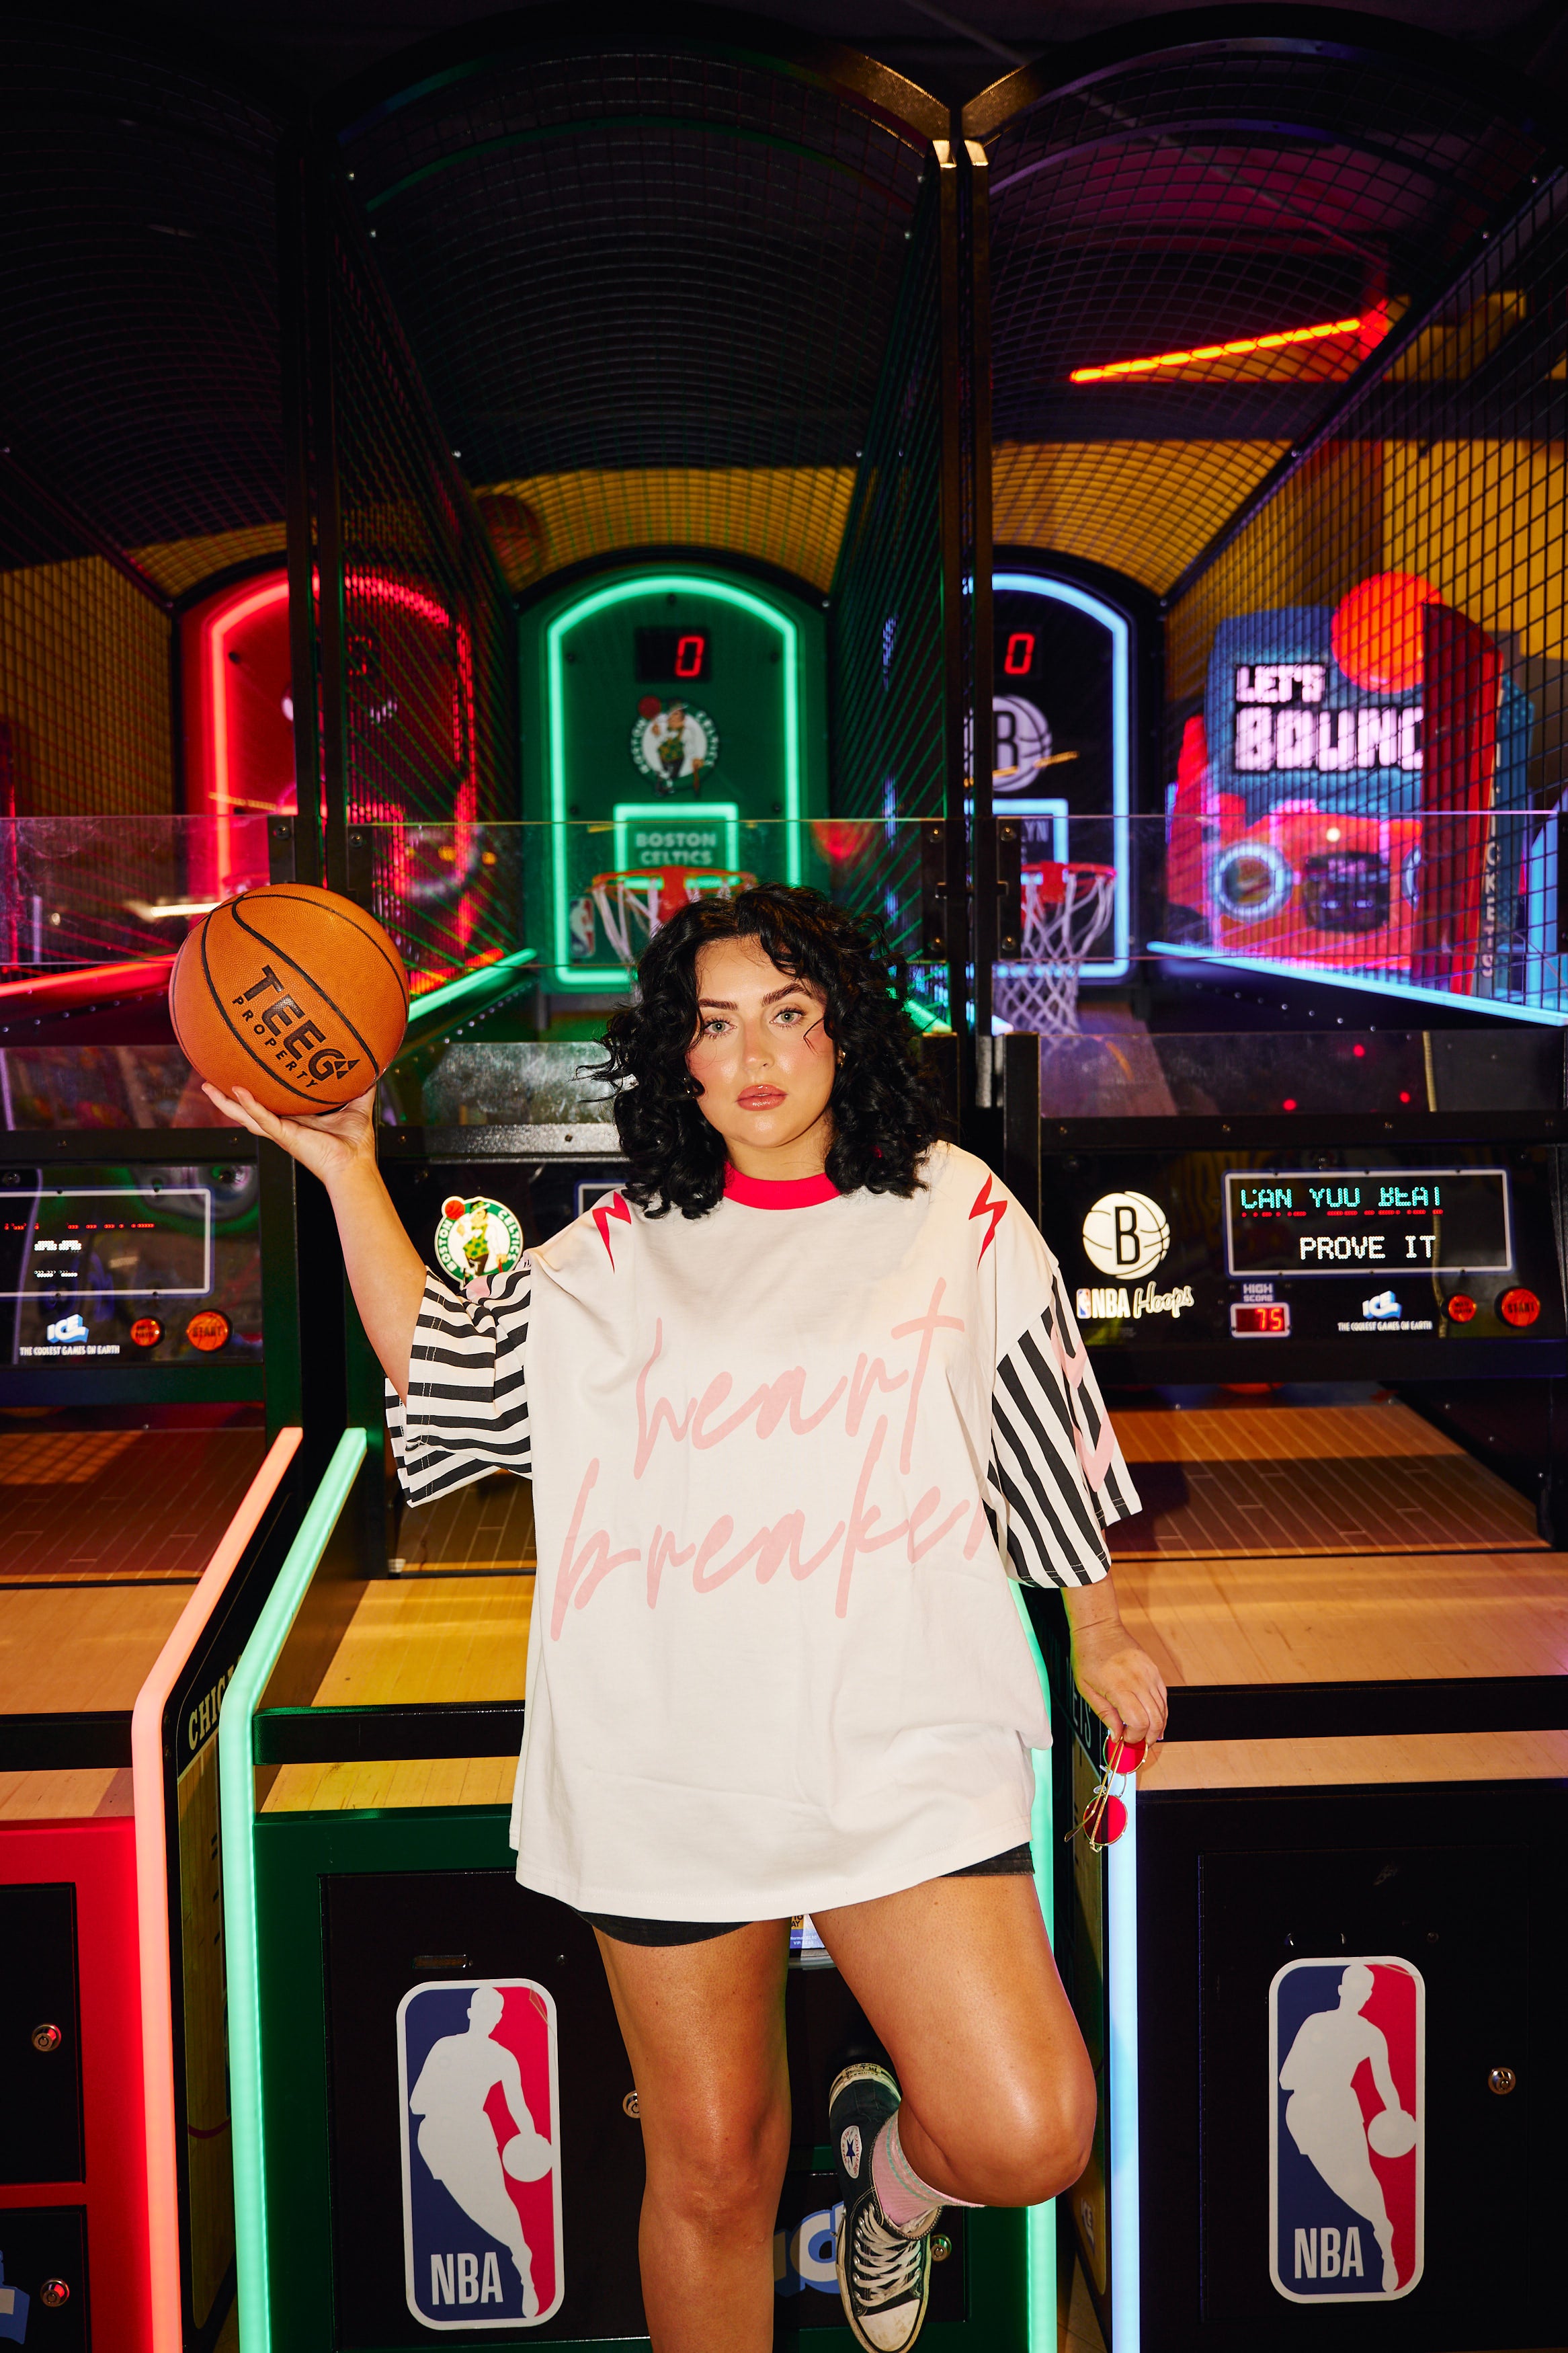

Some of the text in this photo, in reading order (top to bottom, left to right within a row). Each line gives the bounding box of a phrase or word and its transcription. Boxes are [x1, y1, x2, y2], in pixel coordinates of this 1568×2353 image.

[675, 635, 705, 677] 0
[1004, 633, 1035, 674] 0
[1236, 664, 1325, 702] LET'S
[634, 832, 716, 848] BOSTON
[641, 850, 713, 866] CELTICS
[232, 996, 319, 1088] PROPERTY
[243, 964, 346, 1082] TEEG
[437, 1219, 455, 1273] BOSTON
[498, 1209, 521, 1263] CELTICS
[1115, 1206, 1140, 1265] B
[1300, 1235, 1436, 1260] PROVE IT
[1091, 1281, 1194, 1318] NBA Hoops
[1243, 1283, 1273, 1293] HIGH
[1243, 1294, 1274, 1302] SCORE
[1362, 1291, 1403, 1320] ICE
[47, 1314, 89, 1343] ICE
[1255, 1308, 1283, 1331] 75
[1337, 1322, 1350, 1332] THE
[1350, 1321, 1376, 1332] COOLEST
[1377, 1321, 1400, 1331] GAMES
[1411, 1320, 1433, 1330] EARTH
[19, 1347, 33, 1356] THE
[33, 1347, 60, 1356] COOLEST
[61, 1346, 86, 1355] GAMES
[97, 1345, 120, 1355] EARTH
[634, 1277, 965, 1479] heart
[189, 1654, 241, 1750] CHIC
[1294, 2226, 1364, 2279] NBA
[431, 2251, 504, 2306] NBA
